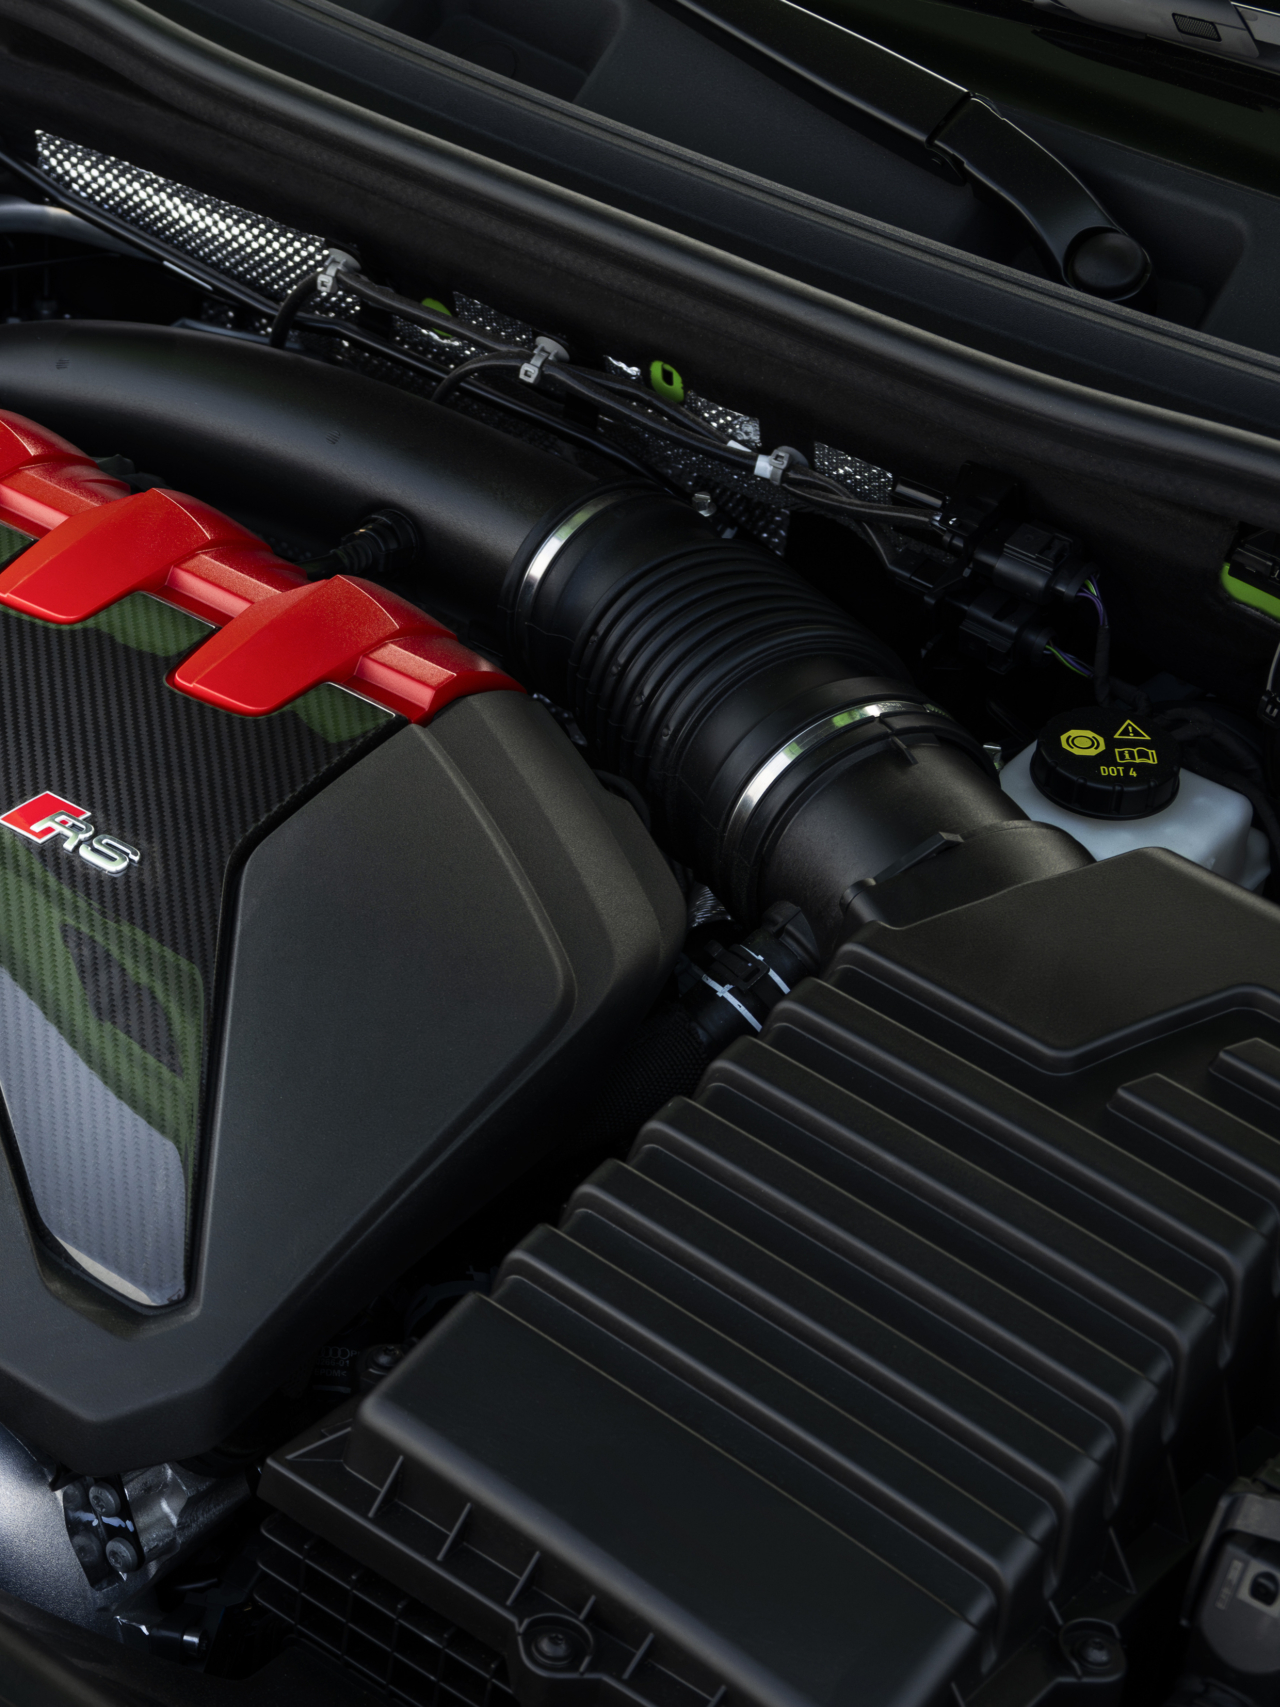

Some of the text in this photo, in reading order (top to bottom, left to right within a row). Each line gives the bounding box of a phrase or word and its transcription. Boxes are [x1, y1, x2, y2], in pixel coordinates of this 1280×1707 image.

[1100, 765, 1137, 777] DOT 4
[26, 808, 140, 874] RS
